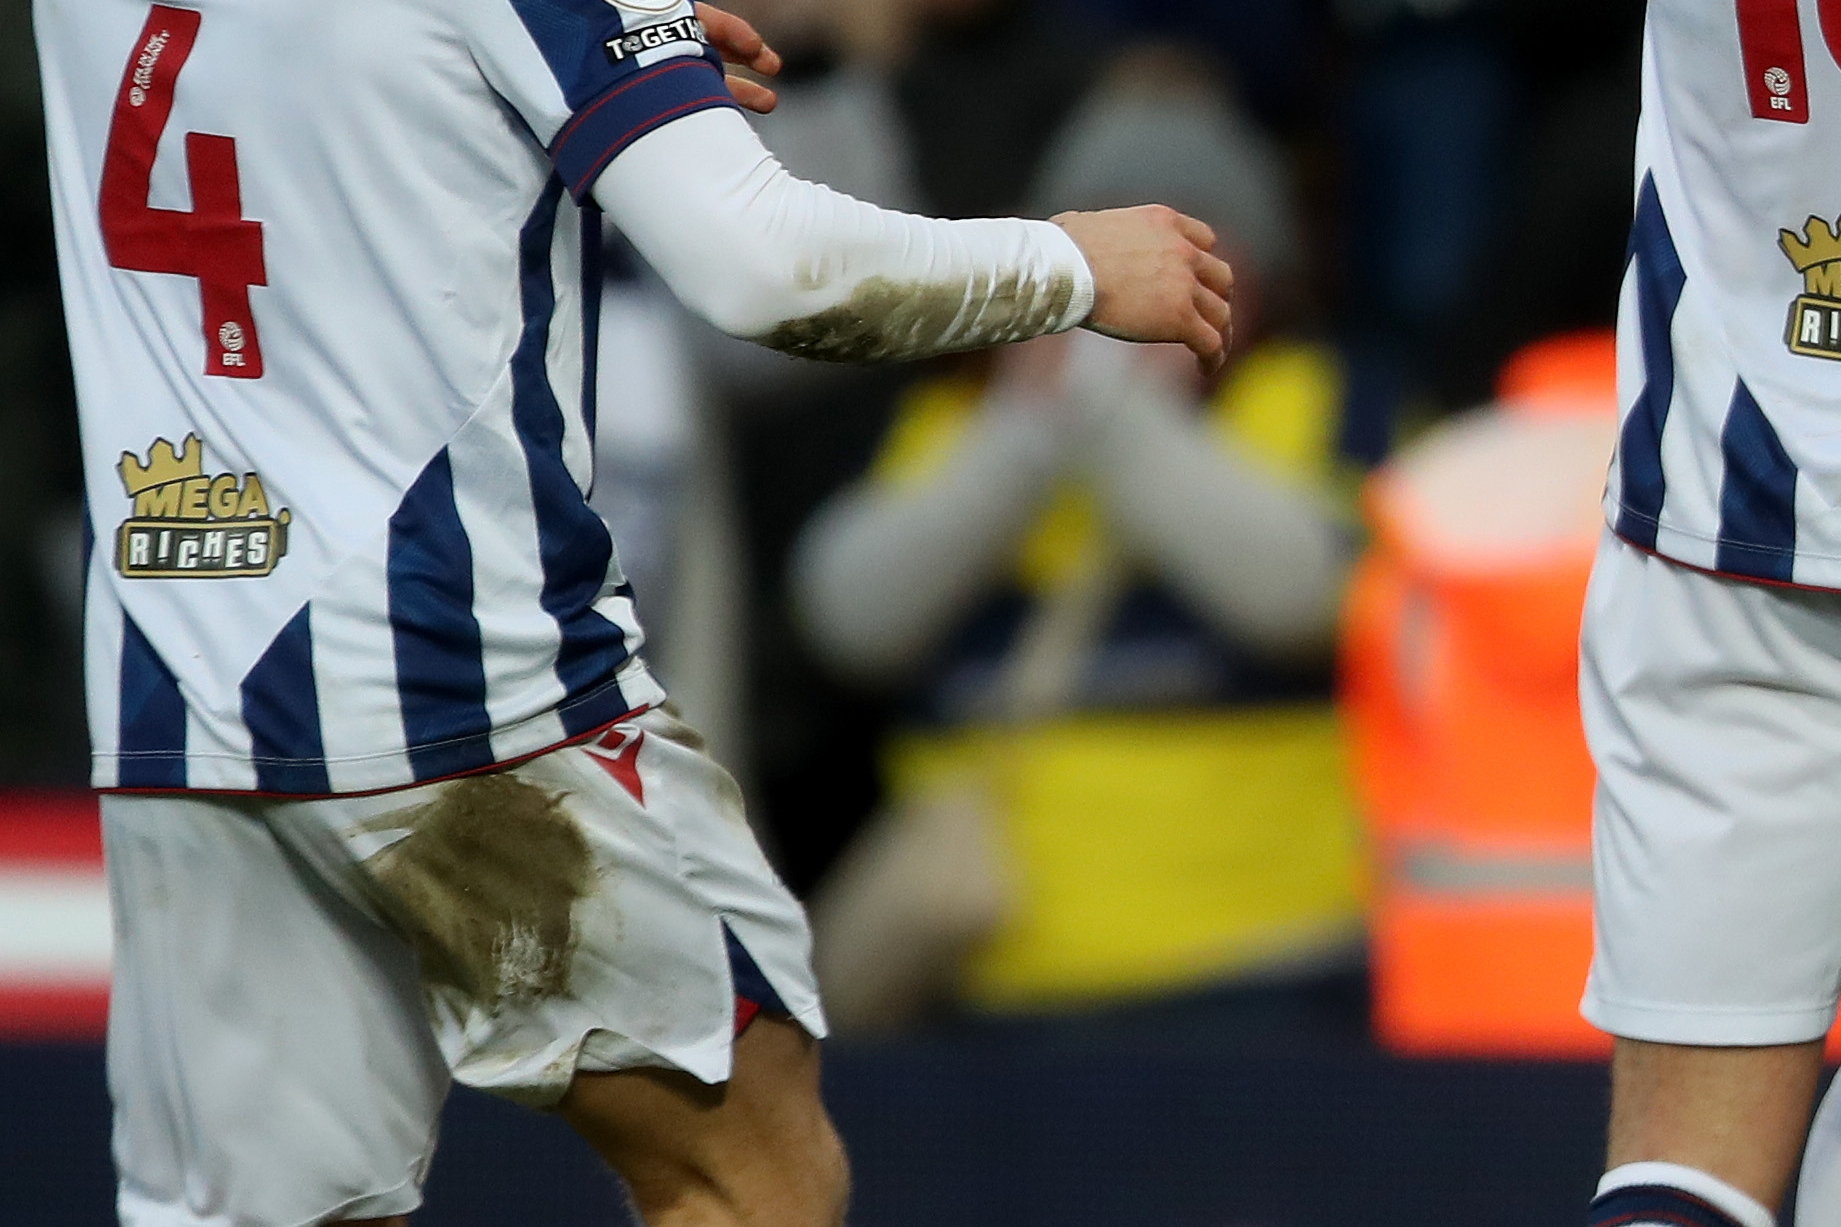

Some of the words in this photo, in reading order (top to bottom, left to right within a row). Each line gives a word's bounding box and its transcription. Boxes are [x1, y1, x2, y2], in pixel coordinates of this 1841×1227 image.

[1769, 96, 1792, 111] EFL
[99, 4, 268, 379] 4
[222, 352, 246, 367] EFL
[134, 473, 270, 519] MEGA
[129, 530, 269, 569] RICHES
